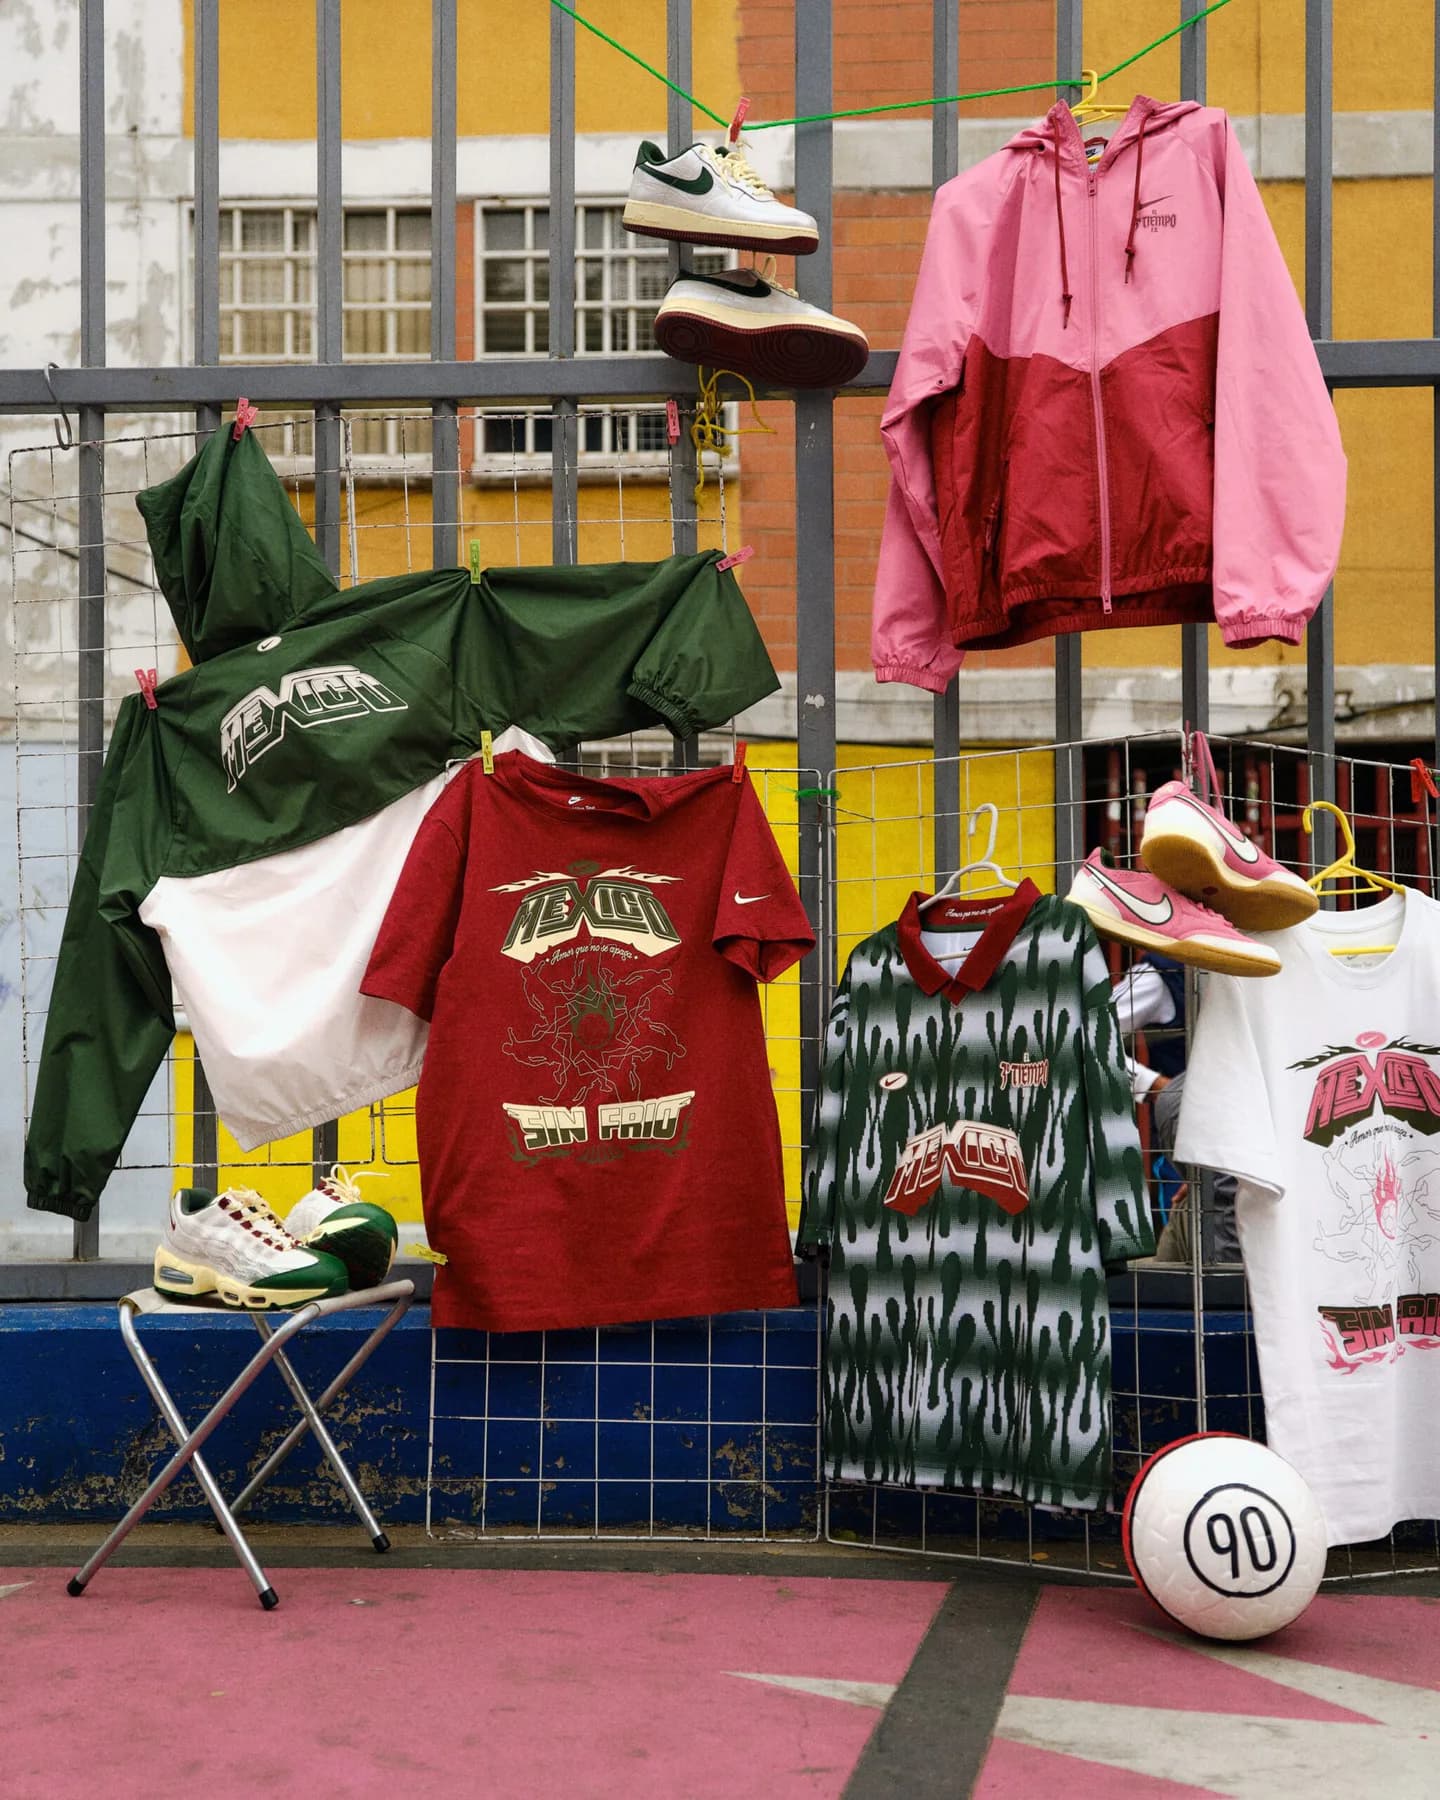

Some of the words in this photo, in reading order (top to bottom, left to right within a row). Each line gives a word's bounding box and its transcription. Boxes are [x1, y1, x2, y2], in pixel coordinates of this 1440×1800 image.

[1142, 214, 1177, 228] TIEMPO
[220, 664, 409, 794] MEXICO
[500, 879, 682, 963] MEXICO
[550, 948, 574, 966] Amor
[575, 945, 589, 959] que
[589, 944, 600, 952] no
[600, 944, 609, 952] se
[608, 945, 633, 961] apaga
[502, 1102, 588, 1151] SIN
[598, 1090, 696, 1141] FRIO
[1303, 1051, 1440, 1147] MEXICO
[884, 1120, 1030, 1216] MEXICO
[1318, 1304, 1395, 1356] SIN
[1397, 1293, 1440, 1338] RI
[1206, 1506, 1278, 1580] 90
